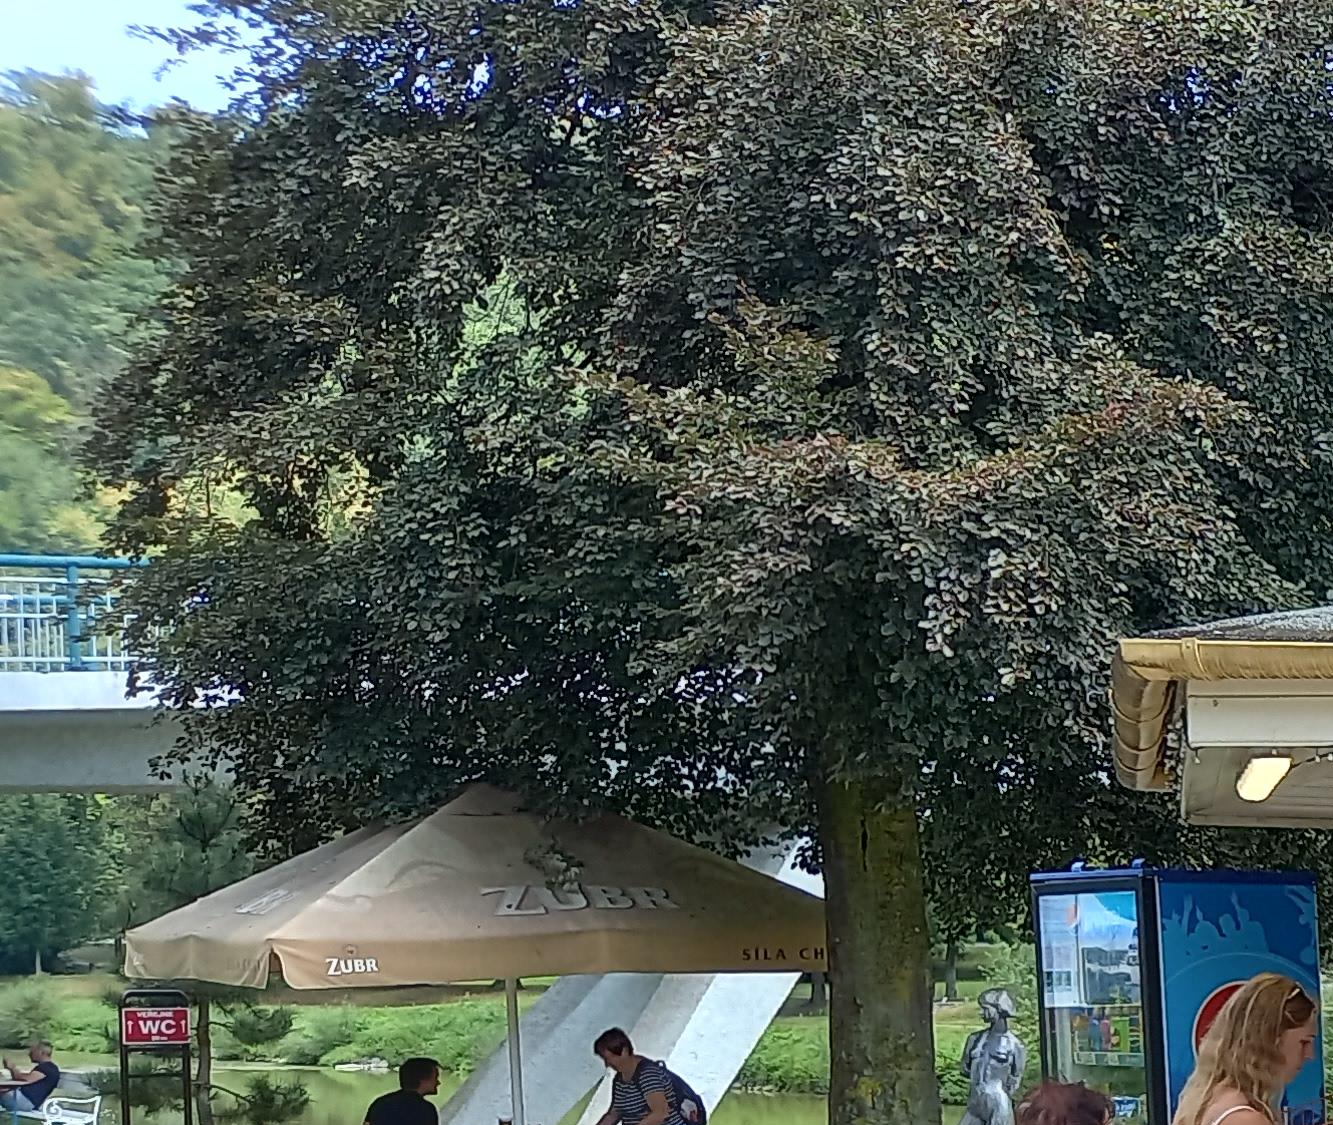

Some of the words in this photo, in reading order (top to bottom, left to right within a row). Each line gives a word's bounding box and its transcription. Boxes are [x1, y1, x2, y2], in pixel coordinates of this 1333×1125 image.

[479, 885, 679, 916] ZUBR
[325, 957, 379, 976] ZUBR
[138, 1020, 177, 1035] WC
